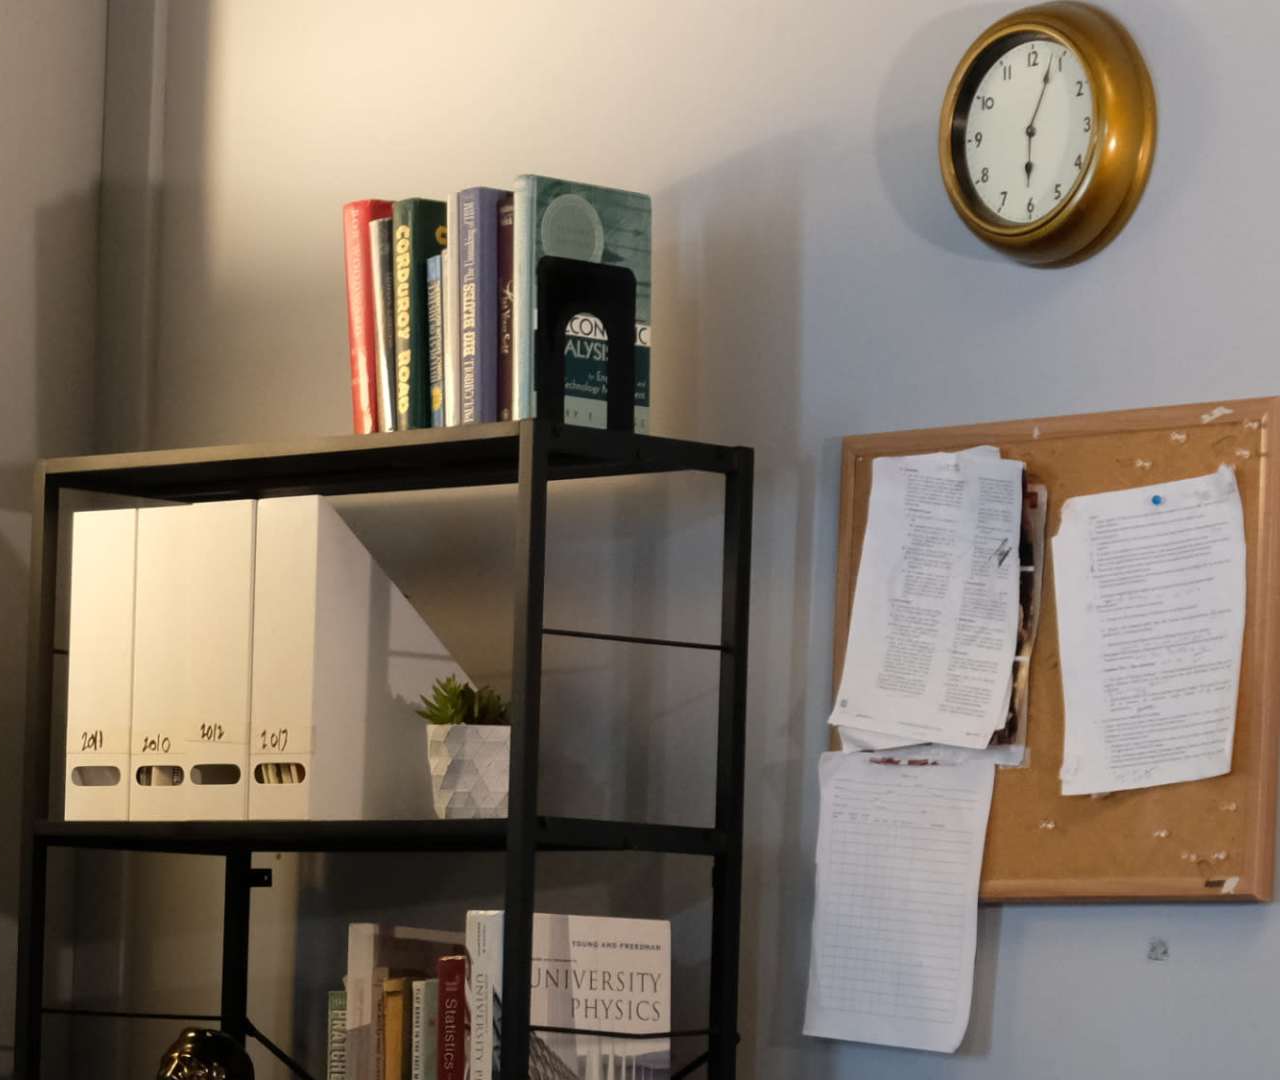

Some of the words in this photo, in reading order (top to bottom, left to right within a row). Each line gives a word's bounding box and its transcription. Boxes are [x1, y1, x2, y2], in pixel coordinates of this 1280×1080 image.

[1026, 51, 1039, 67] 12
[1058, 57, 1063, 72] 1
[1003, 65, 1012, 80] 11
[1076, 81, 1084, 97] 2
[981, 96, 994, 110] 10
[1083, 117, 1091, 132] 3
[974, 132, 983, 148] 9
[1074, 154, 1083, 169] 4
[981, 168, 989, 183] 8
[1000, 191, 1008, 206] 7
[1054, 184, 1062, 200] 5
[1026, 197, 1035, 213] 6
[396, 225, 412, 339] CORDUROY
[463, 282, 476, 329] BLUES
[463, 332, 476, 357] BIG
[396, 349, 411, 414] ROAD
[463, 359, 475, 400] CARROLL
[564, 380, 600, 394] echnology
[463, 400, 475, 424] PAUL
[80, 730, 104, 752] 2011
[141, 733, 171, 753] 2010
[571, 940, 599, 948] YOUNG
[619, 943, 662, 951] FREEDMAN
[531, 967, 662, 993] UNIVERSITY
[473, 973, 487, 1062] UNIVERSITY
[570, 997, 662, 1022] PHYSICS
[442, 998, 459, 1070] Statistics
